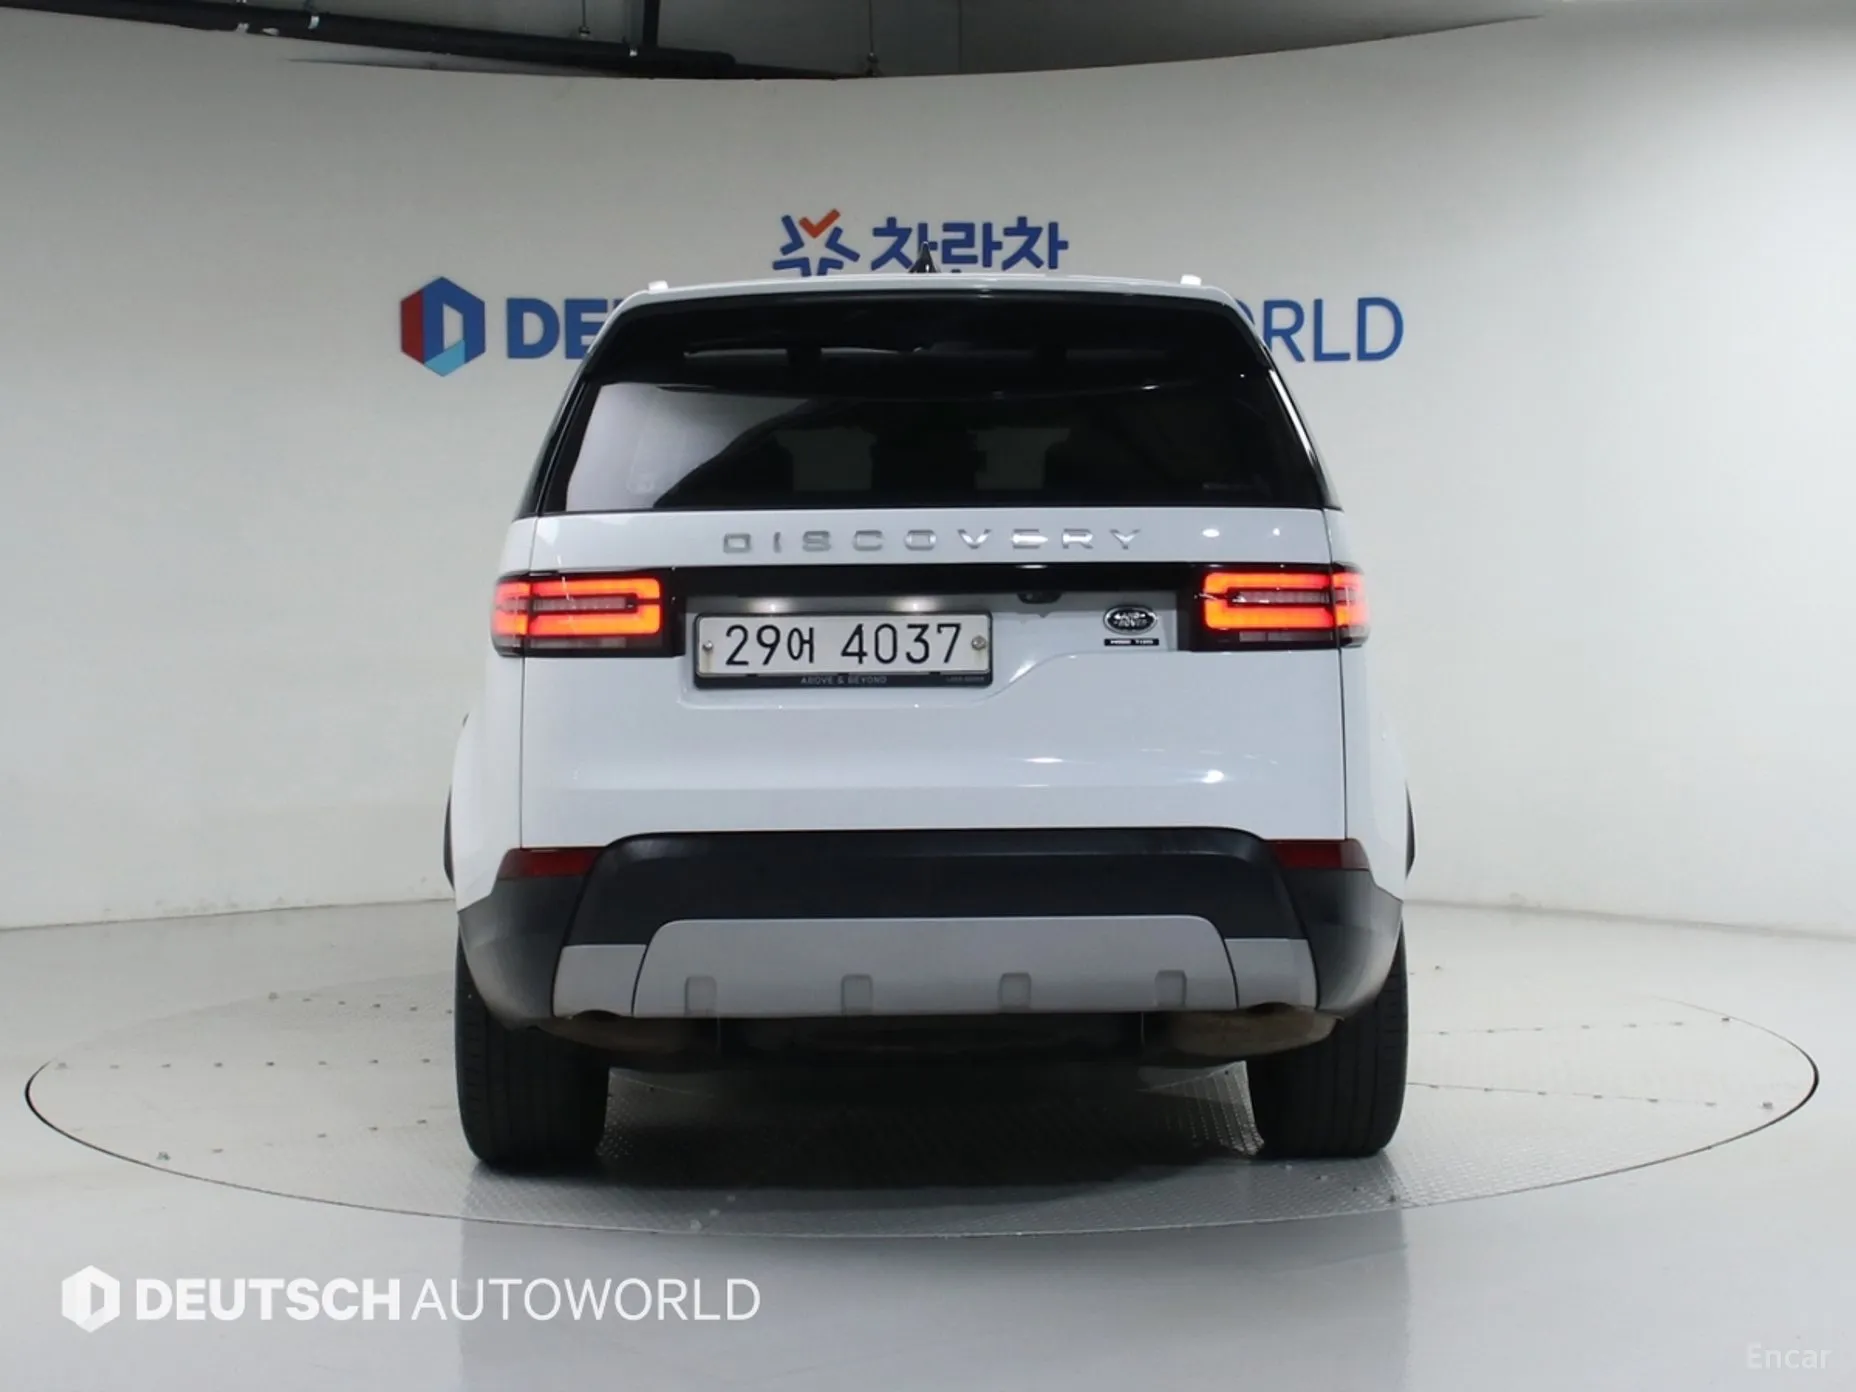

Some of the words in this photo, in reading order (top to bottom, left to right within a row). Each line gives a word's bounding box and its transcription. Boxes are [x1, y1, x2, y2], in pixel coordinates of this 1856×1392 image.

[506, 297, 624, 360] DE
[1235, 297, 1404, 362] RLD
[723, 528, 1141, 554] DISCOVERY
[725, 623, 815, 666] 29어
[840, 622, 962, 665] 4037
